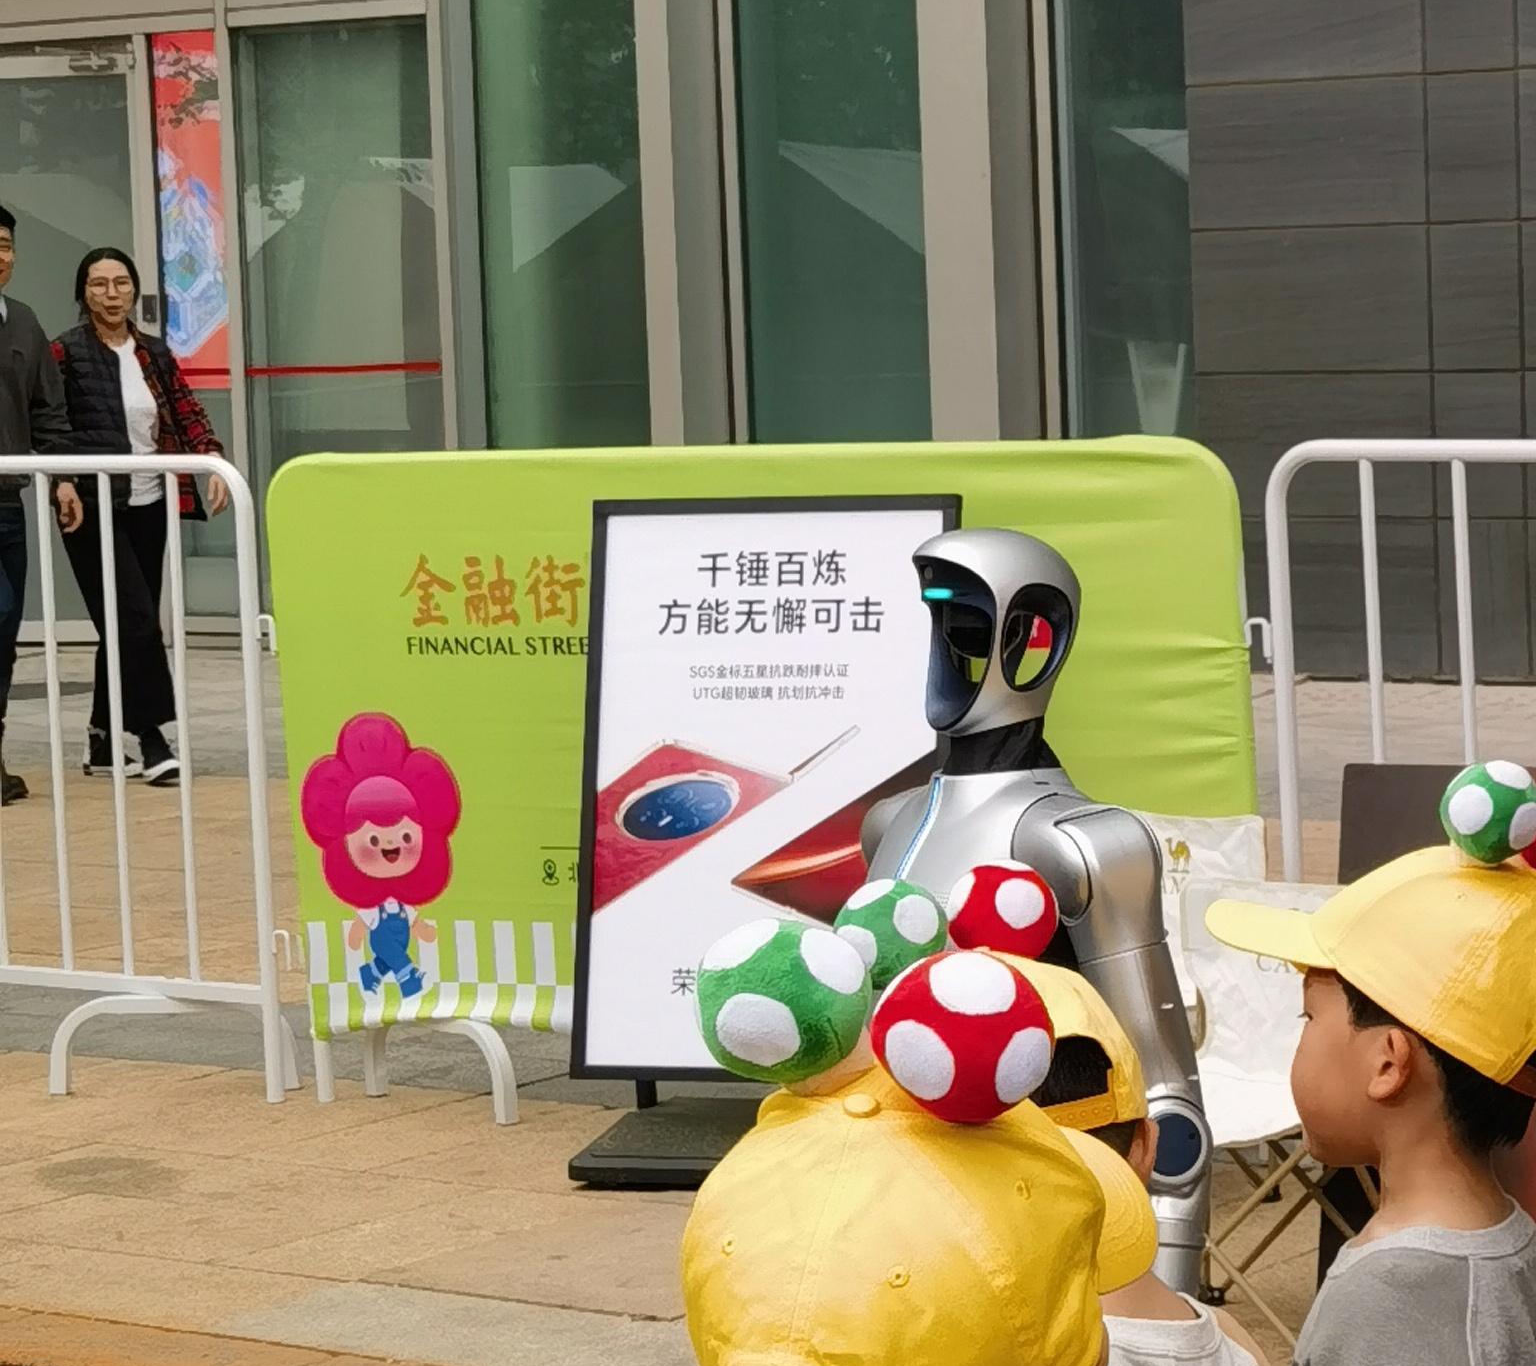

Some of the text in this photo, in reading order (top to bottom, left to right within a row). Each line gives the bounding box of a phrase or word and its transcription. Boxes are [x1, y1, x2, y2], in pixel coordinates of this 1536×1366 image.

[697, 549, 847, 587] 千锤百炼
[400, 553, 586, 628] 金融街
[658, 596, 885, 635] 方能无懈可击
[407, 636, 521, 656] FINANCIAL
